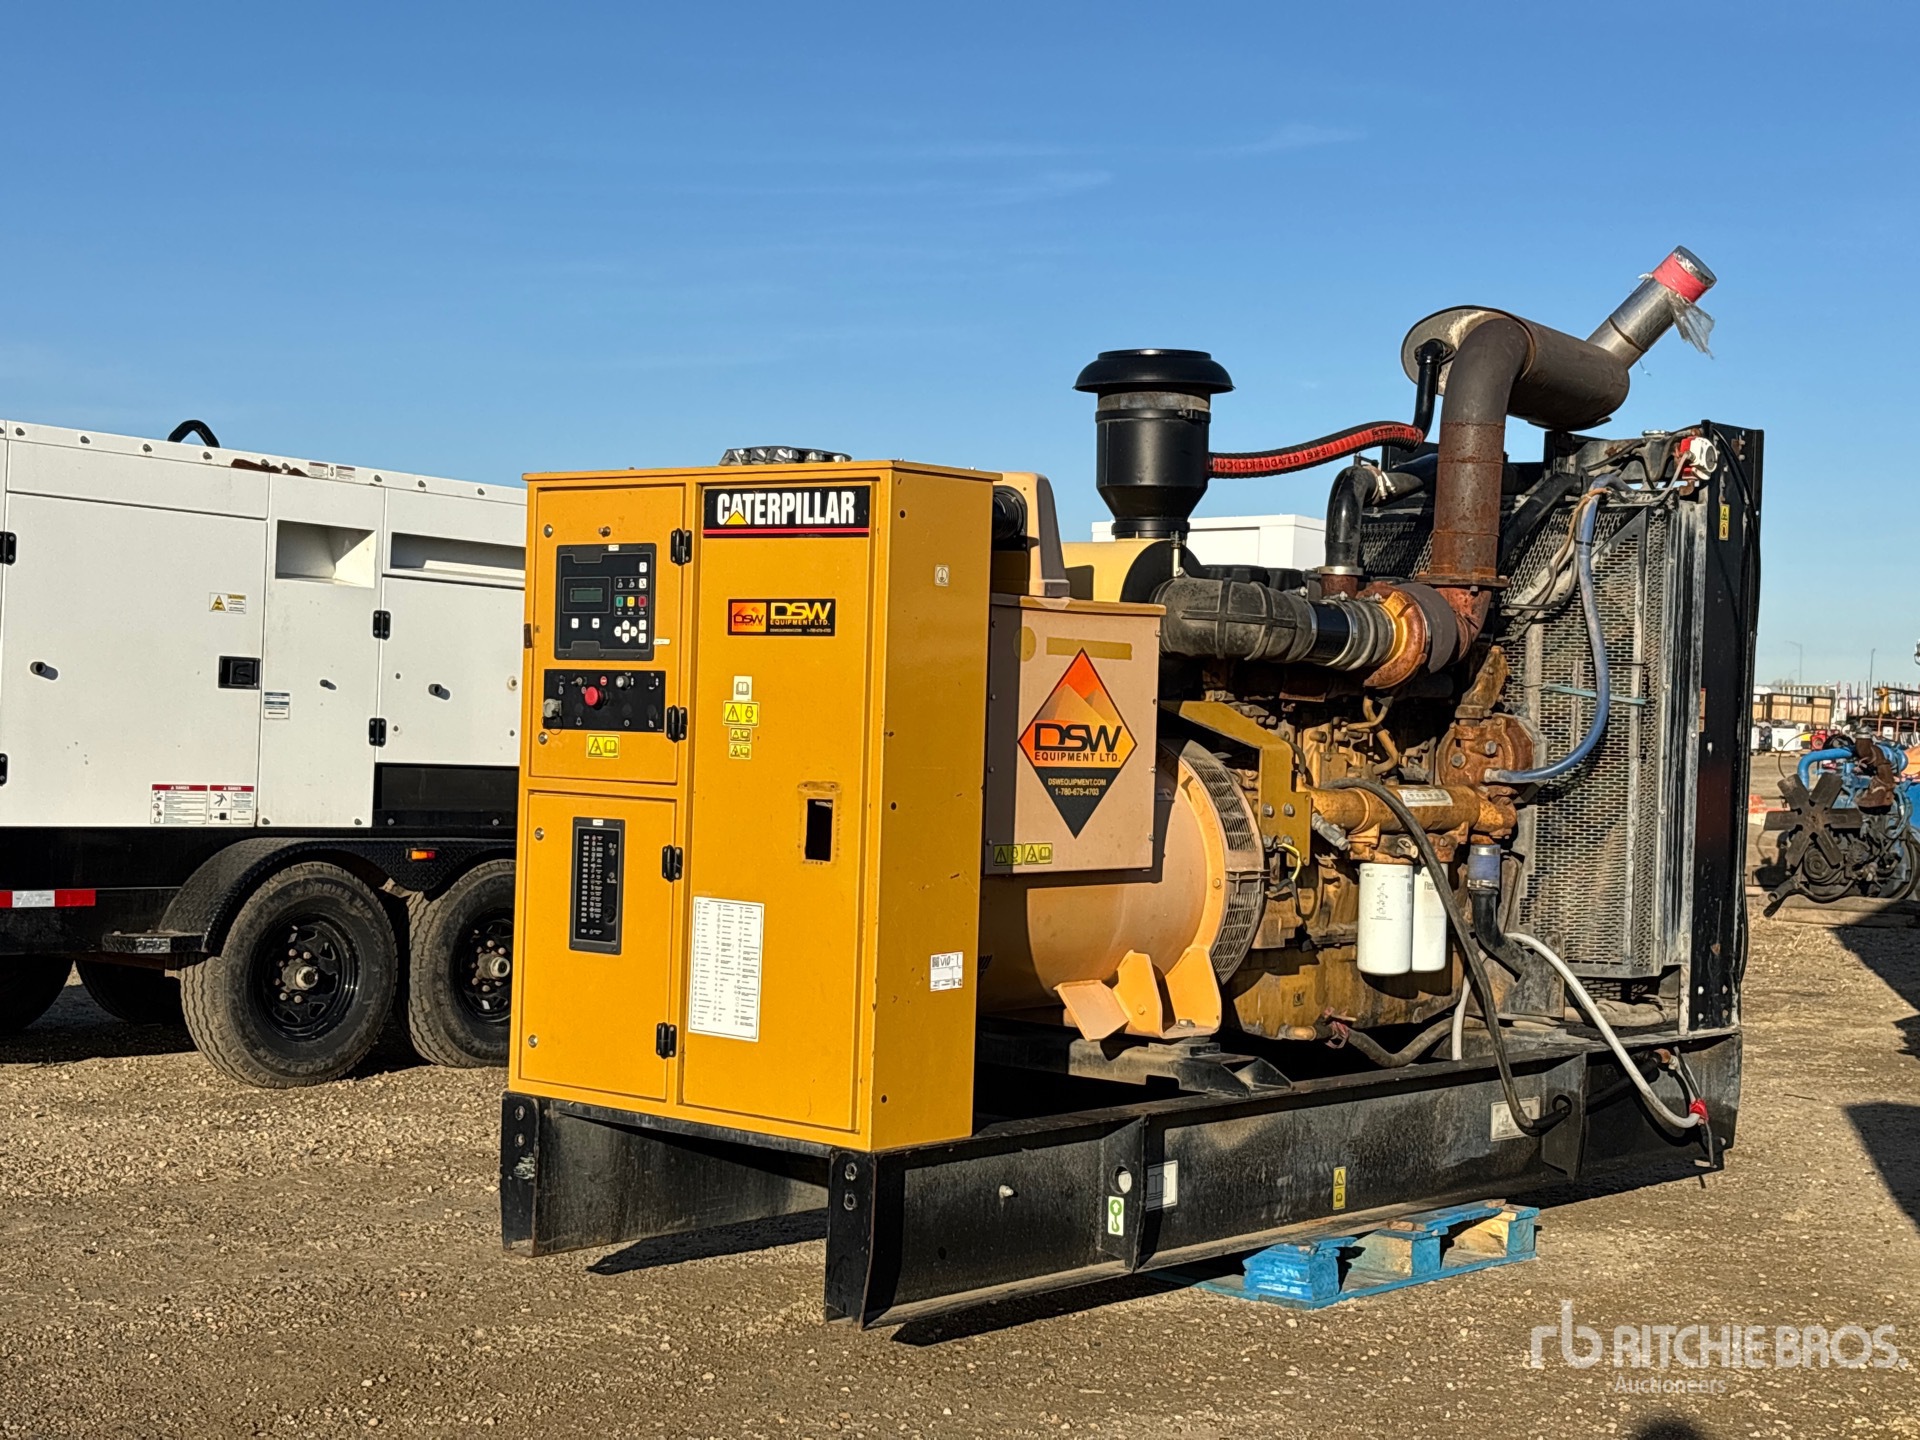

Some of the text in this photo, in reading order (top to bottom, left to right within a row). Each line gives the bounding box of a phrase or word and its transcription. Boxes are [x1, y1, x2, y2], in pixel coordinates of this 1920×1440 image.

[717, 491, 855, 525] CATERPILLAR
[770, 602, 832, 620] DSW
[734, 615, 764, 624] DSW
[1034, 723, 1122, 752] DSW
[1034, 752, 1121, 762] EQUIPMENT LTD.
[1047, 778, 1107, 786] DSWEQUIPMENT.COM
